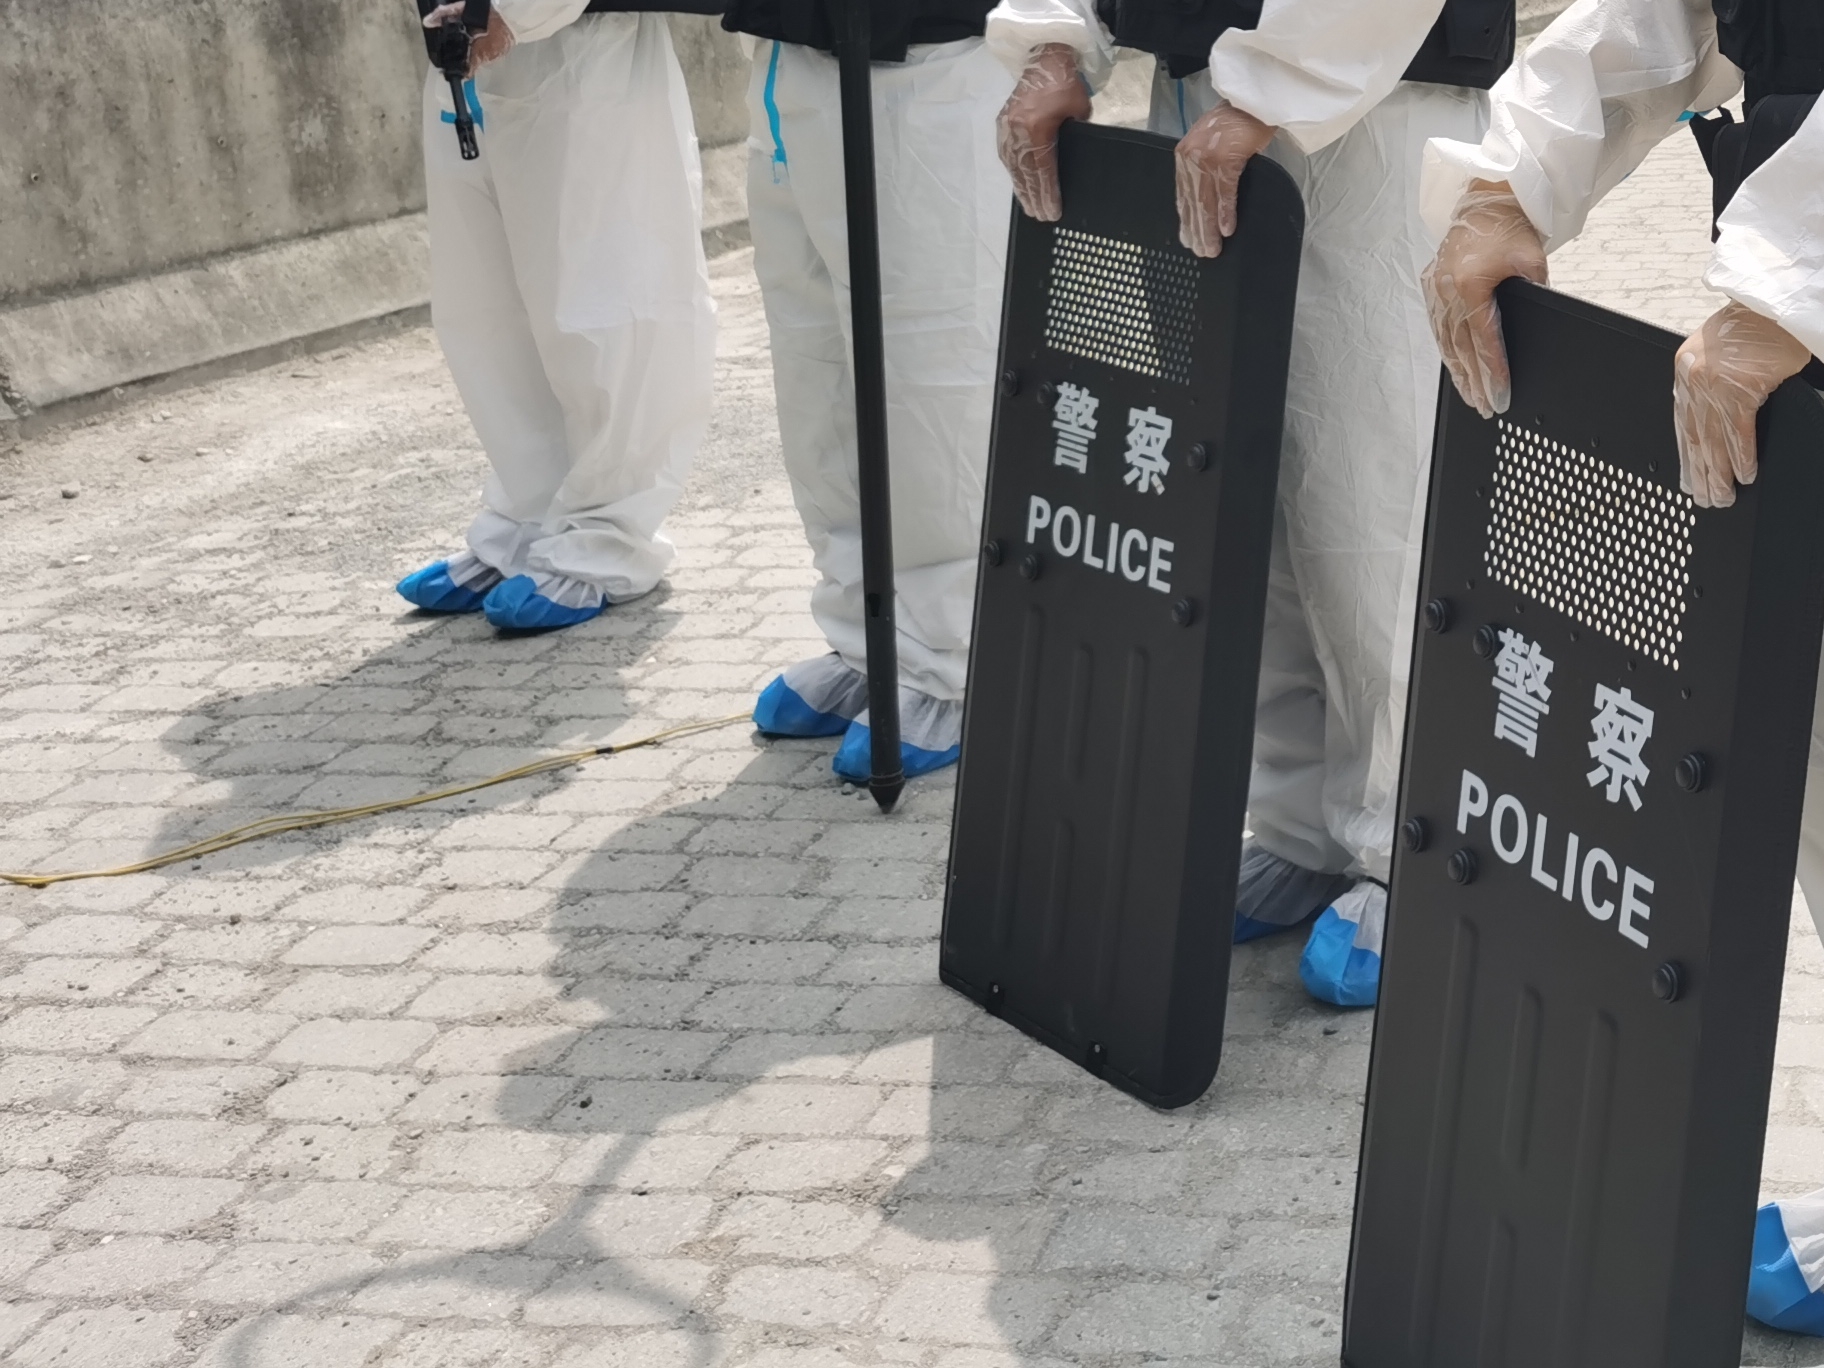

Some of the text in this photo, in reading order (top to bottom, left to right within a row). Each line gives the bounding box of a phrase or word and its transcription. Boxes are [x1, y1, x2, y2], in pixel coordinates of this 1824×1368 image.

[1052, 381, 1173, 496] 警察
[1026, 495, 1175, 594] POLICE
[1492, 627, 1655, 812] 警察
[1456, 768, 1655, 950] POLICE
